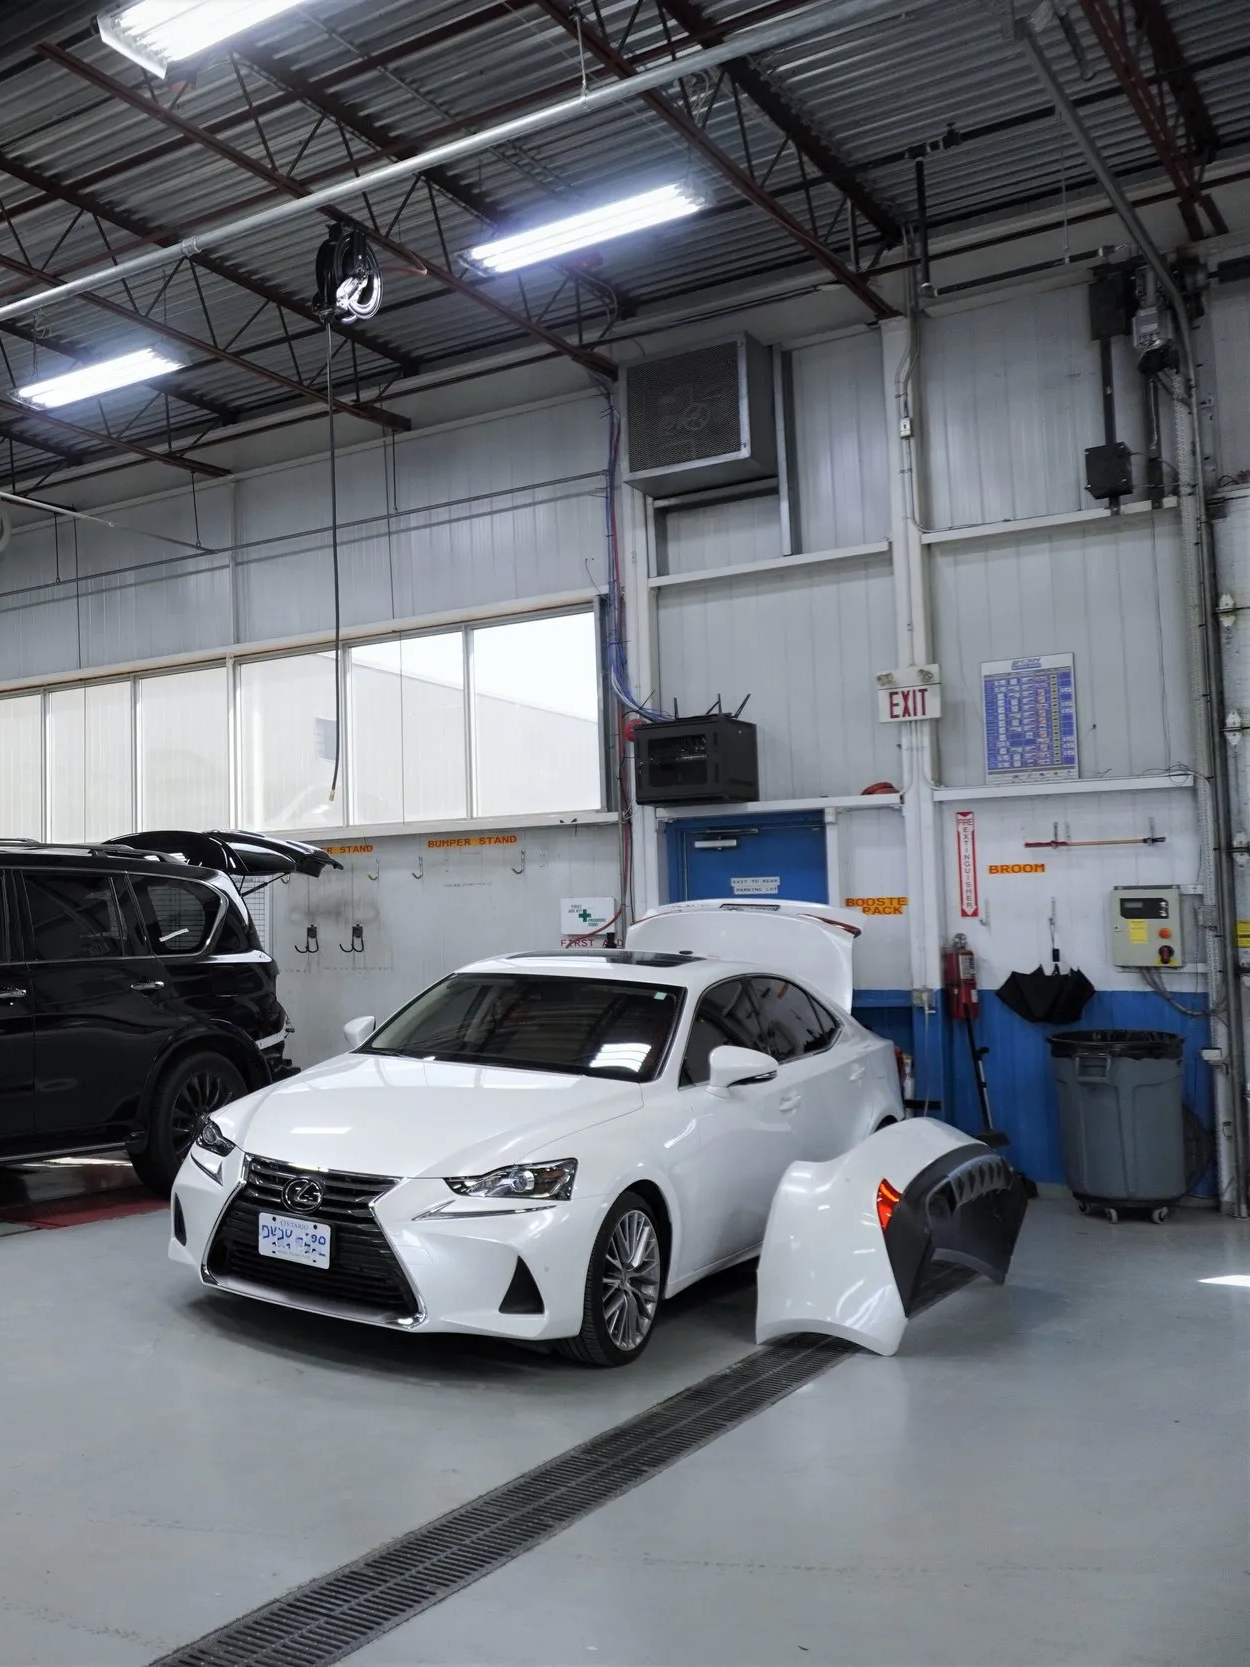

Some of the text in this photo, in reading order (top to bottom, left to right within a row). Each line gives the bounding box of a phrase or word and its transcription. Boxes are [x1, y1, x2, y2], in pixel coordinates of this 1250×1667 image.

[889, 688, 928, 719] EXIT
[427, 835, 518, 849] BUMPER STAND
[339, 844, 374, 854] STAND
[963, 826, 973, 909] EXTINGUISHER
[989, 863, 1045, 875] BROOM
[862, 906, 903, 915] PACK
[560, 939, 624, 948] FIRST AD
[280, 1220, 309, 1230] ONTARIO
